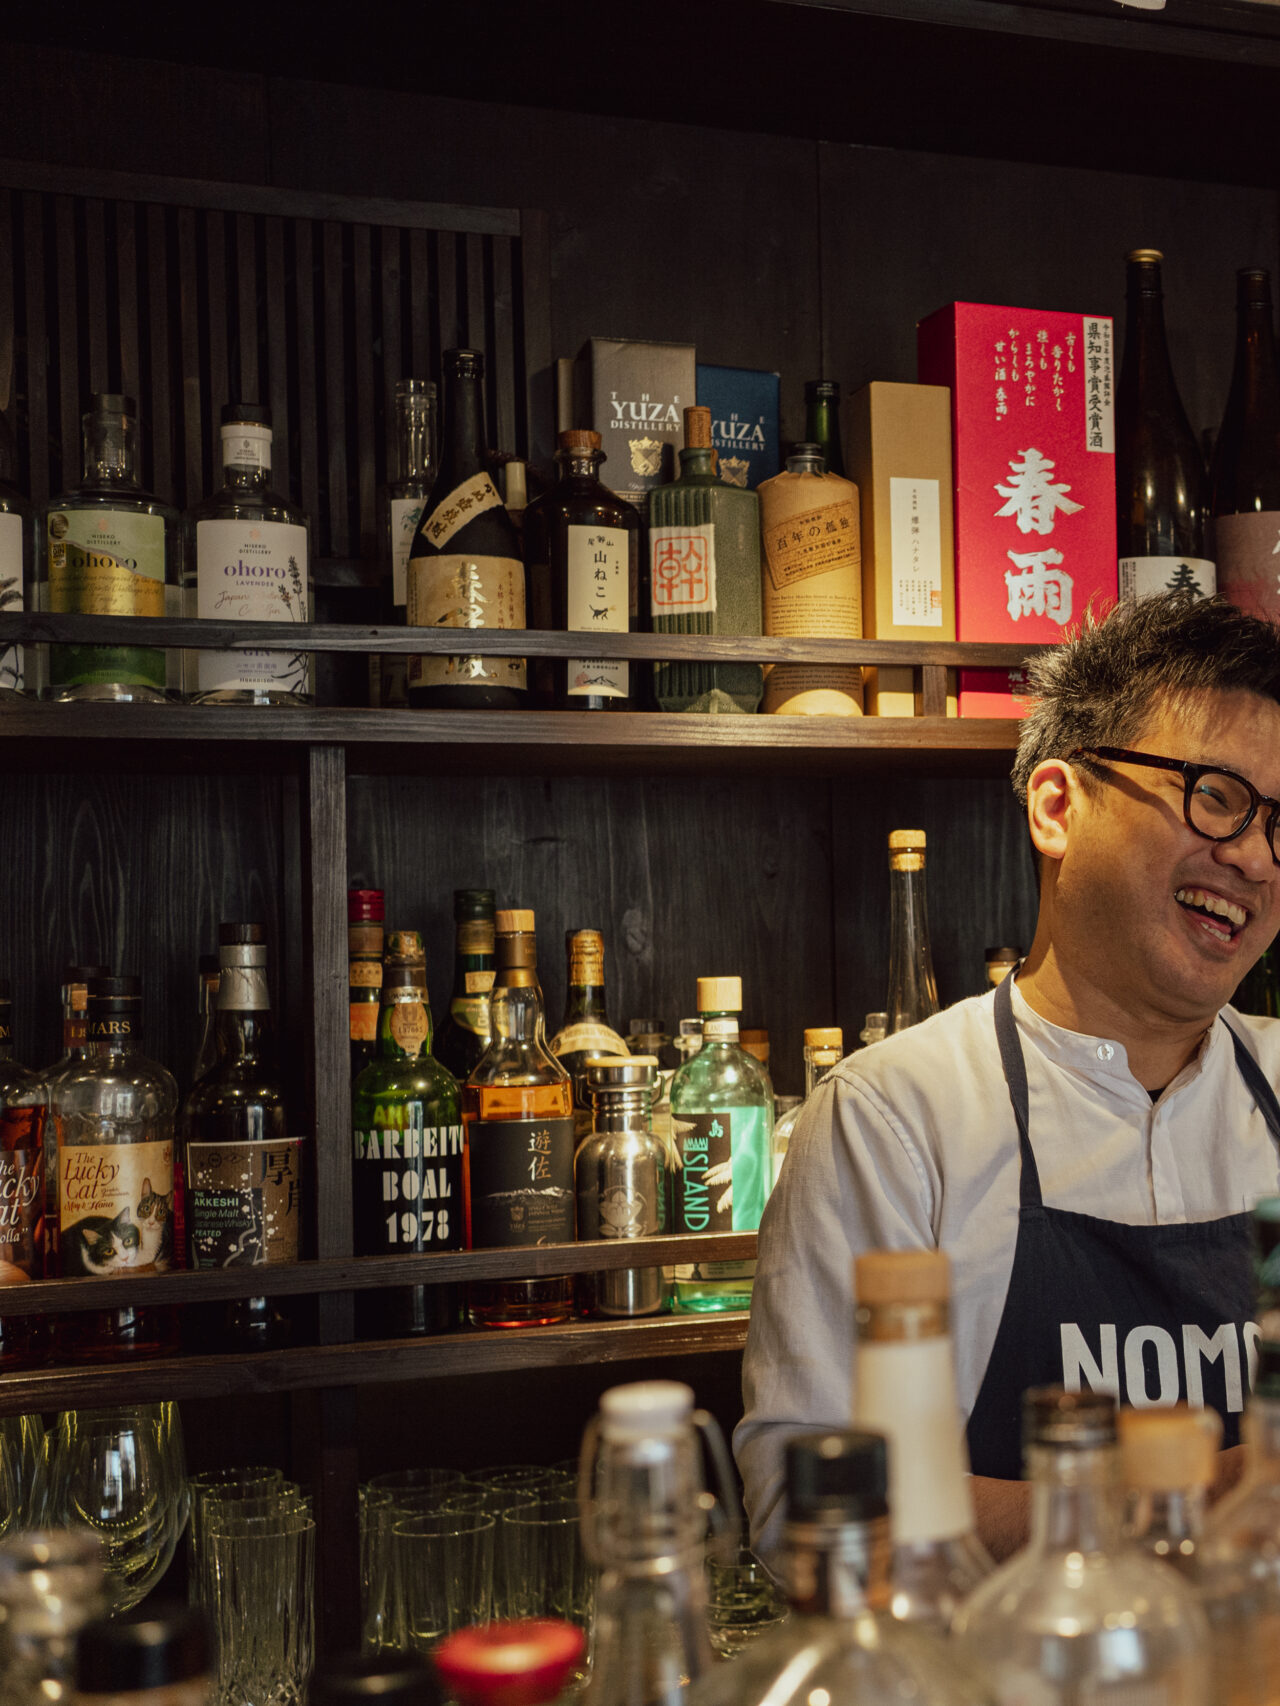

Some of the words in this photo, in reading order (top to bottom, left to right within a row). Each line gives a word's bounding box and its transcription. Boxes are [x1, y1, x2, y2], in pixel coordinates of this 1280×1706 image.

[1087, 322, 1103, 448] 県知事賞受賞酒
[611, 391, 680, 404] THE
[610, 400, 681, 423] YUZA
[730, 413, 765, 424] HE
[610, 420, 681, 432] DISTILLERY
[776, 516, 850, 552] 百年の孤独
[993, 447, 1085, 625] 春雨
[72, 552, 138, 570] ohoro
[224, 559, 287, 580] ohoro
[594, 550, 607, 598] 山ねこ
[235, 580, 275, 588] LAVENDER
[88, 1021, 132, 1035] MARS
[74, 1152, 95, 1164] The
[527, 1128, 552, 1182] 遊佐
[64, 1157, 120, 1187] Lucky
[66, 1178, 98, 1200] Cat
[382, 1167, 452, 1202] BOAL
[194, 1197, 239, 1207] AKKESHI
[218, 1209, 239, 1218] Malt
[224, 1218, 251, 1229] Whisky
[385, 1208, 450, 1244] 1978
[194, 1229, 222, 1238] PEATED
